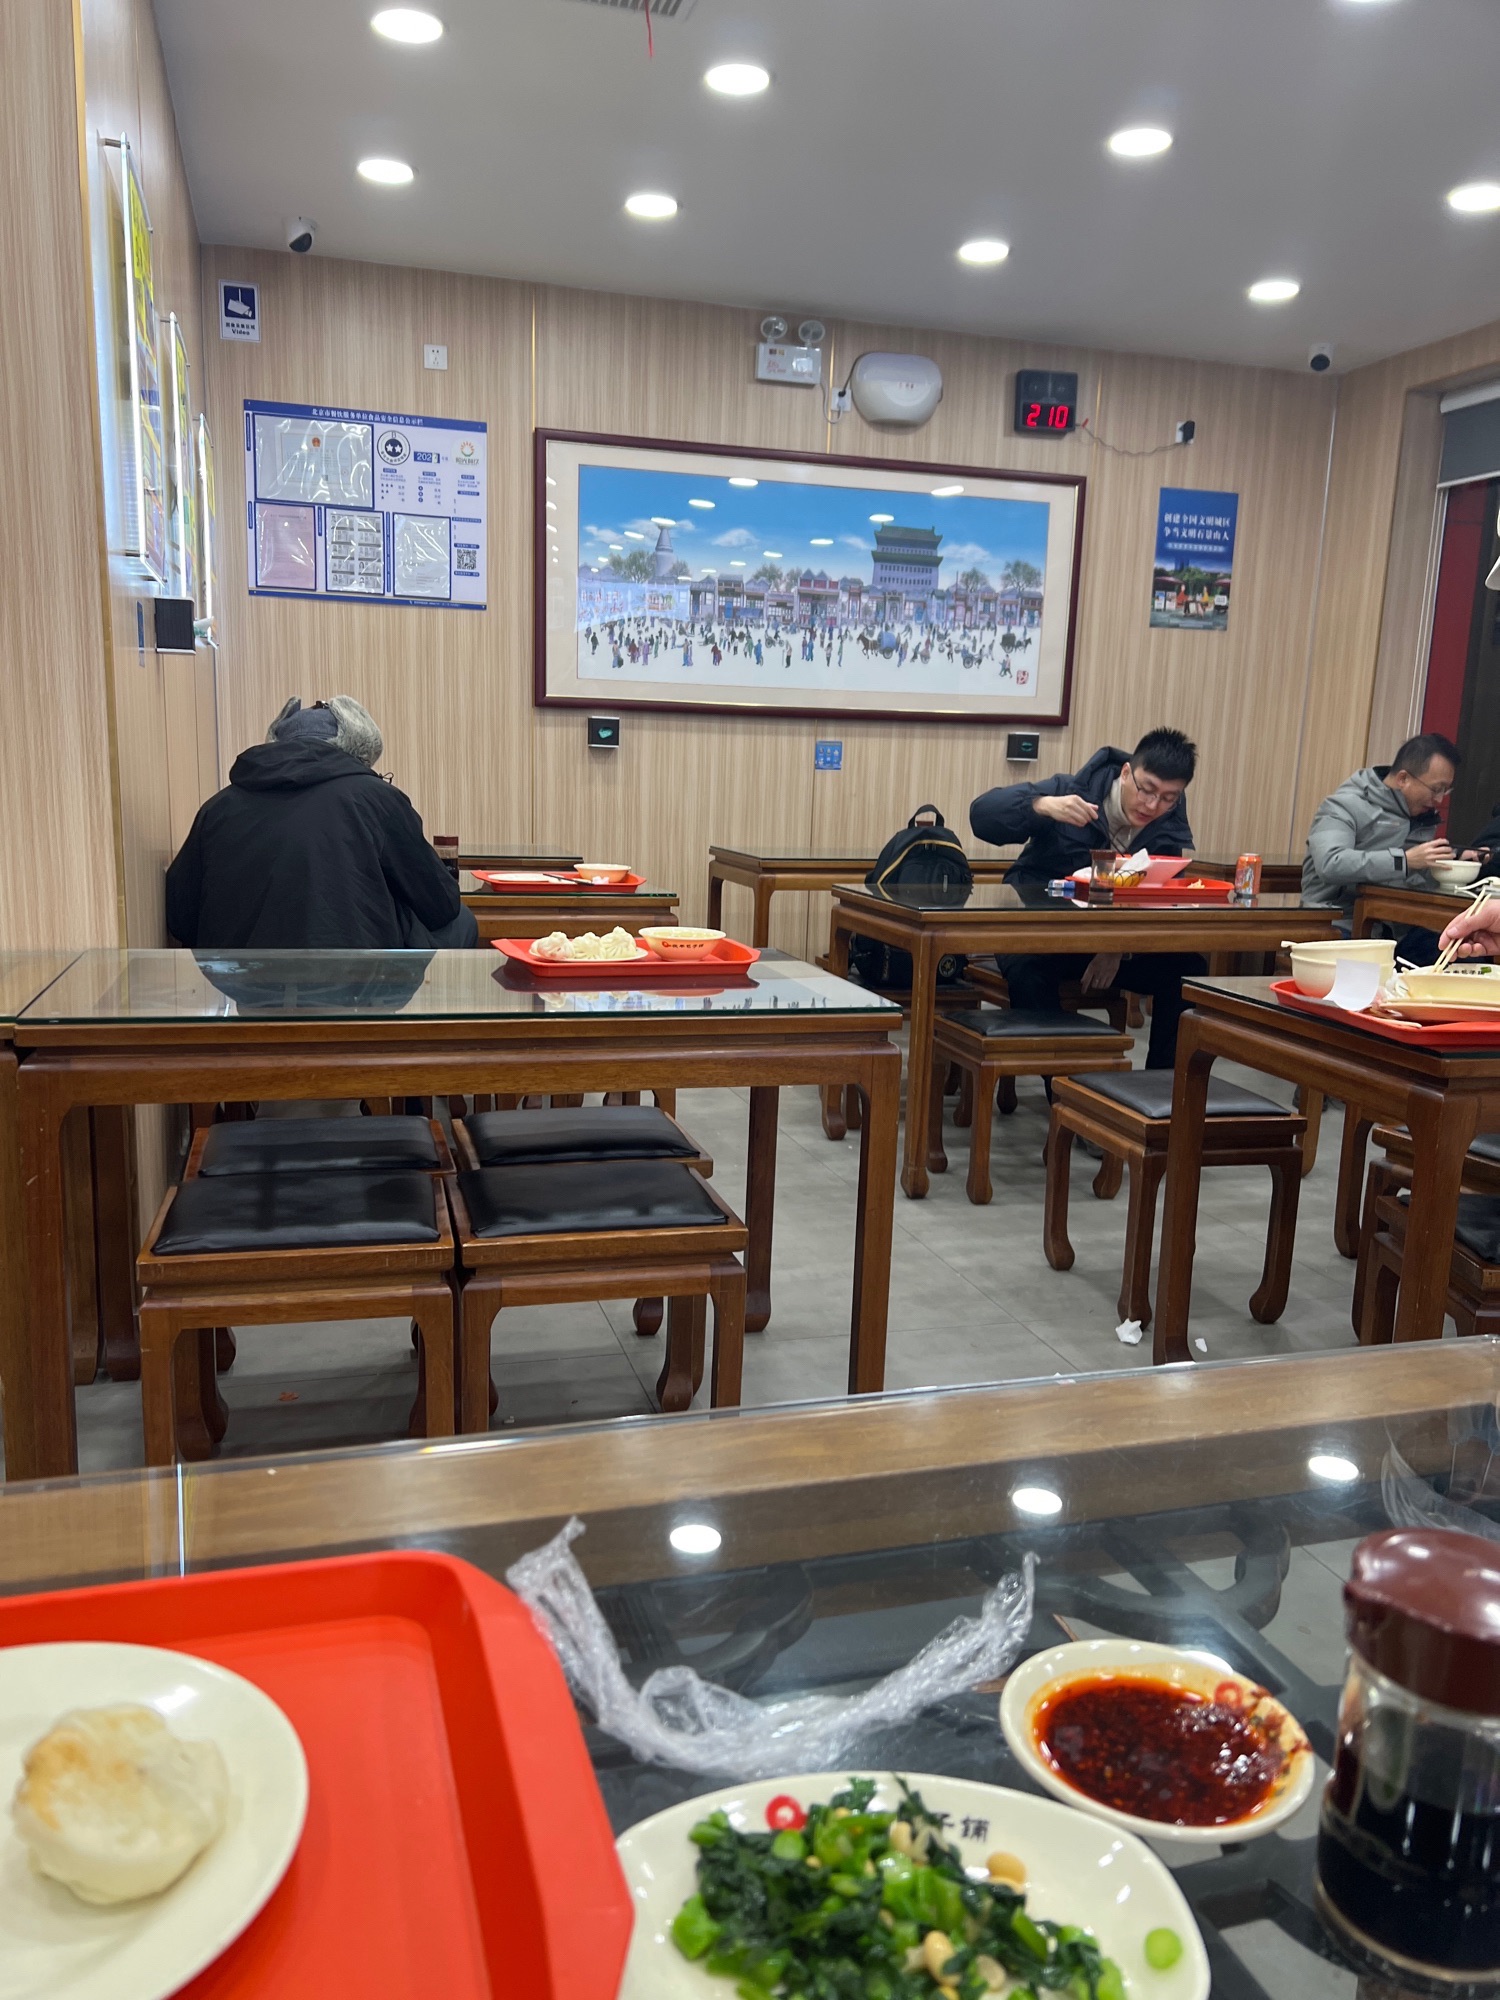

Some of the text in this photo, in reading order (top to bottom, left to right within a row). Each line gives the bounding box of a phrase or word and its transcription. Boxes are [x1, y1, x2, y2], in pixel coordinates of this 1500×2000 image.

[232, 328, 250, 336] Video
[1164, 512, 1231, 528] 创建全国文明城区
[1164, 526, 1230, 541] 争当文明石景山人
